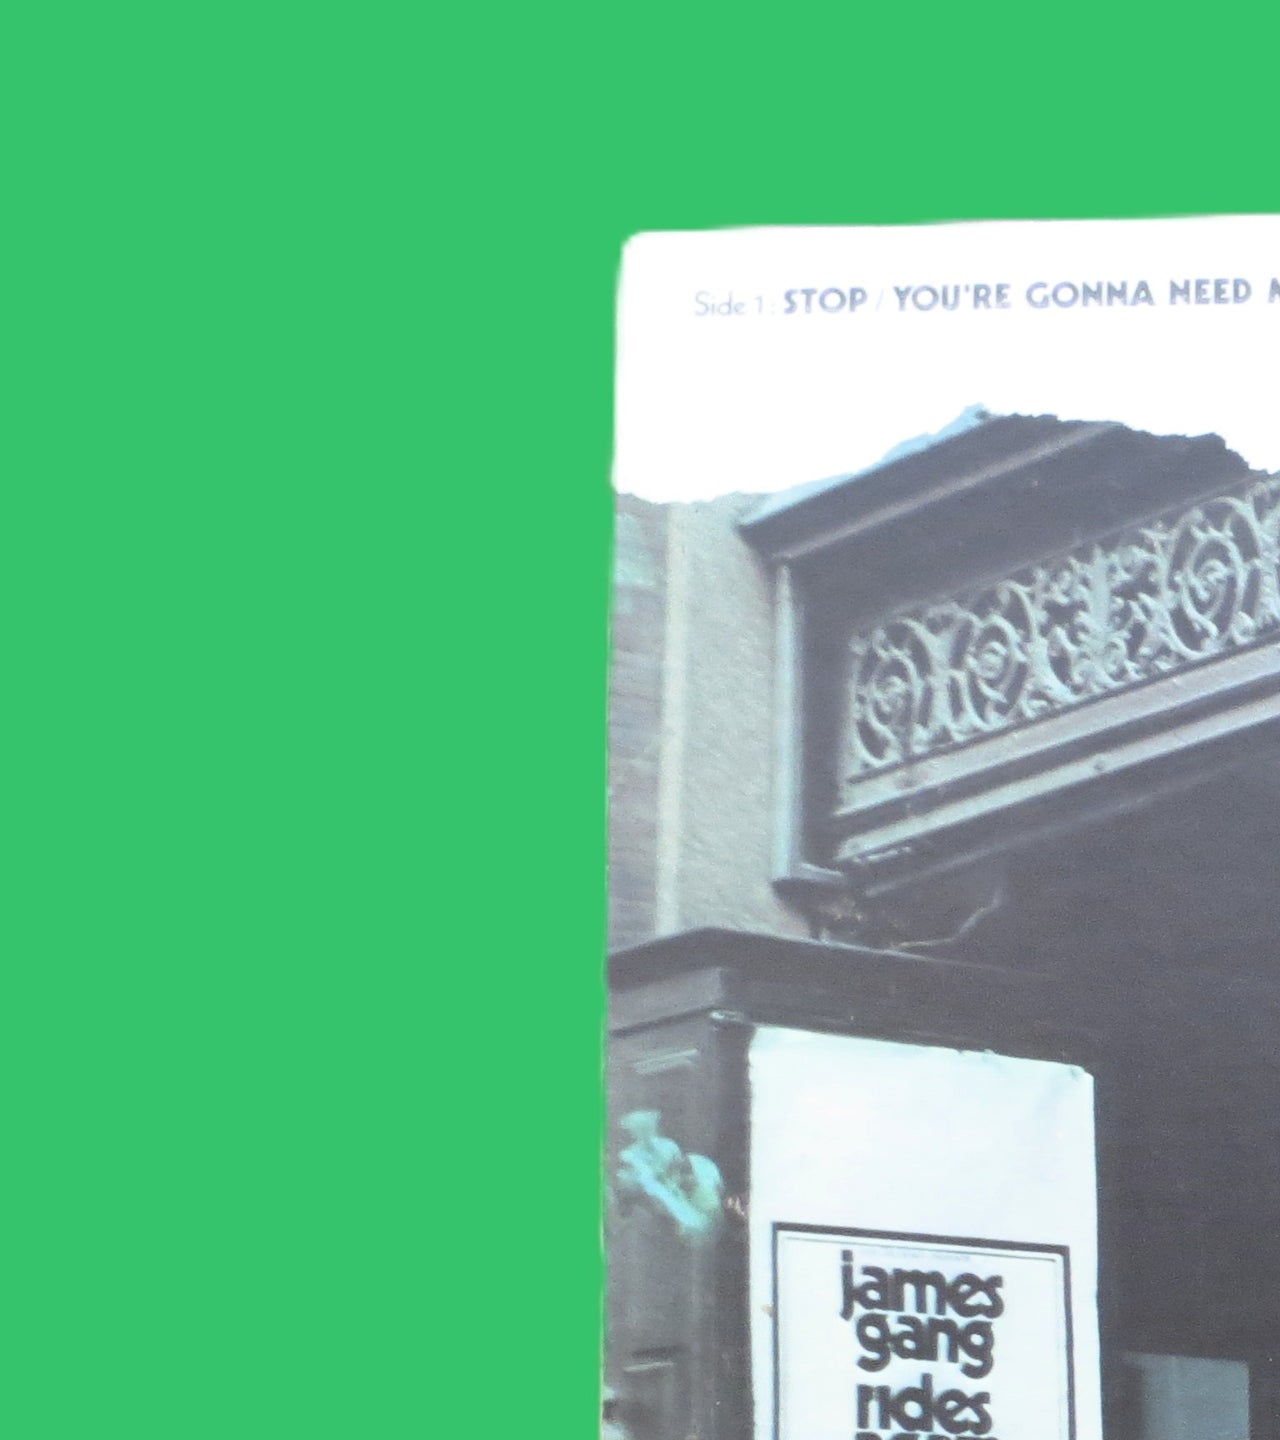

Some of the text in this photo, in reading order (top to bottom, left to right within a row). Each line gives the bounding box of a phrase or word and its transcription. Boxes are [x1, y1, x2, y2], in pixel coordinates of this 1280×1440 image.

[694, 290, 747, 317] Side
[783, 287, 868, 315] STOP
[892, 283, 1012, 312] YOU'RE
[1025, 280, 1156, 310] GONNA
[1168, 278, 1253, 306] NEED
[840, 1249, 1004, 1321] james
[856, 1313, 995, 1380] gang
[856, 1373, 993, 1435] rides
